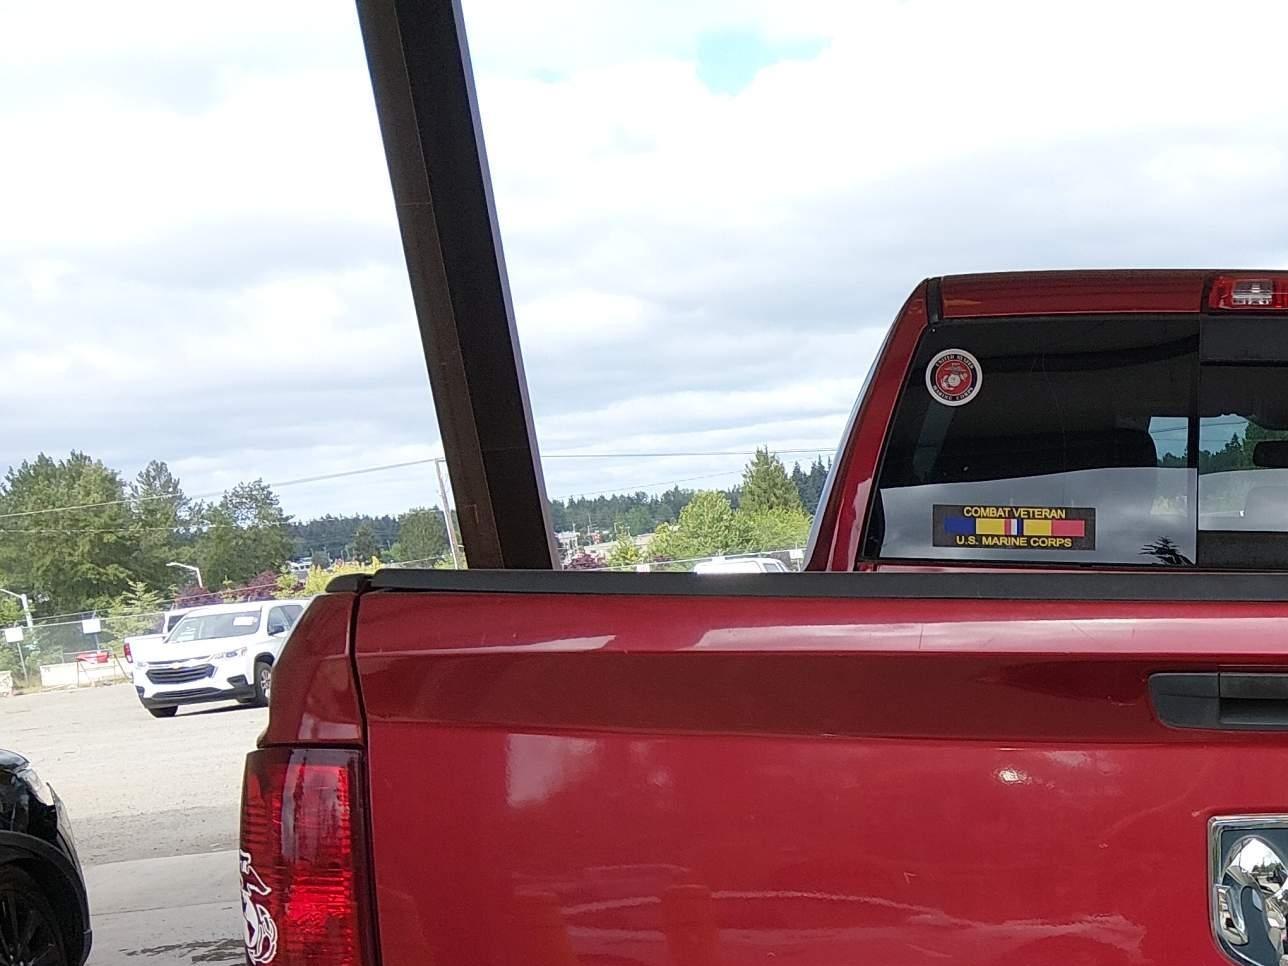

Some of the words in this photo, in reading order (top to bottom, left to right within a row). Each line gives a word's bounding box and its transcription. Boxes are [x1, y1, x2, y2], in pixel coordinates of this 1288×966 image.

[963, 506, 1011, 518] COMBAT
[1013, 508, 1066, 519] VETERAN
[956, 535, 979, 545] U.S.
[982, 537, 1028, 547] MARINE
[1030, 537, 1073, 548] CORPS
